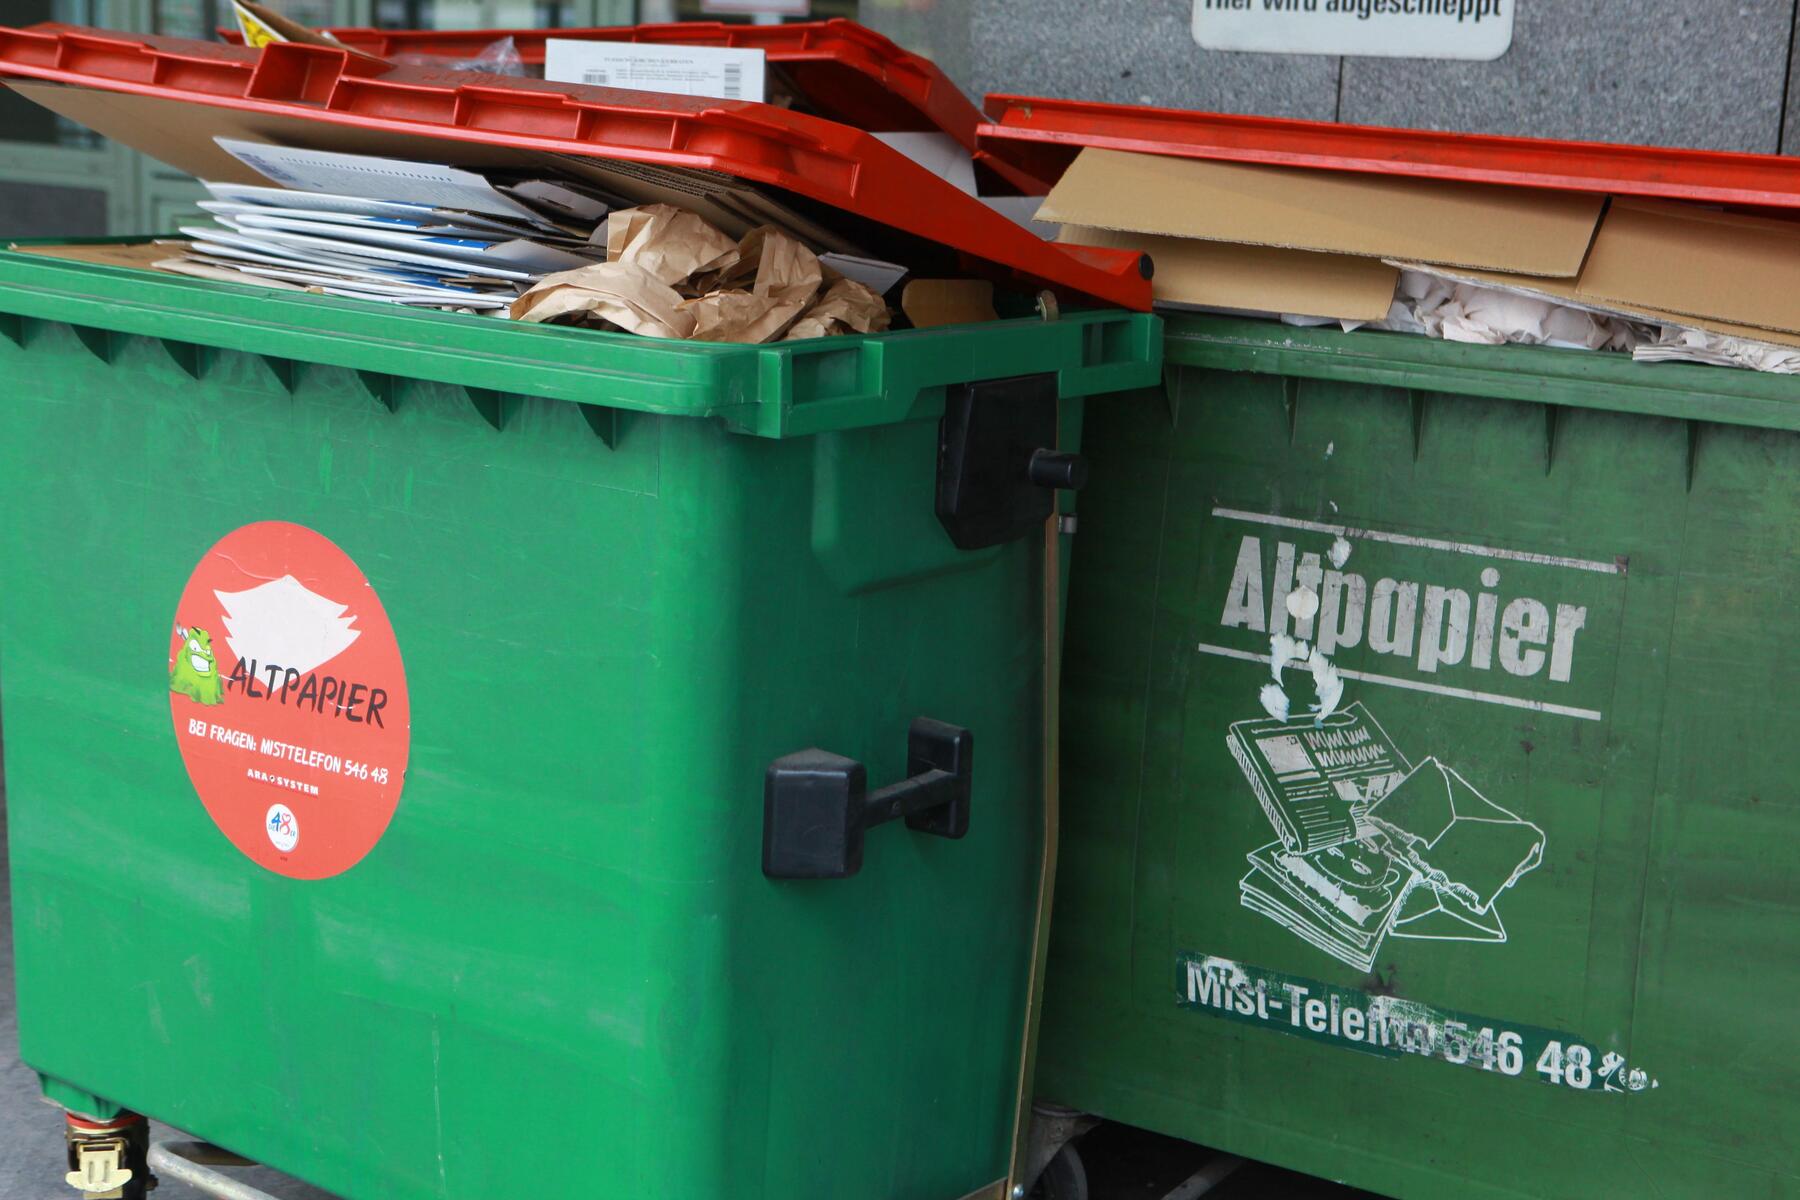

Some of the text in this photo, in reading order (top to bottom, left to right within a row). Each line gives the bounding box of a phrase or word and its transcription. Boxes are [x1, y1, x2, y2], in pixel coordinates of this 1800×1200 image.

[1220, 535, 1587, 683] Altpapier
[226, 656, 388, 729] ALTPAPIER
[188, 718, 388, 785] BEI FRAGEN: MISTTELEFON 546 48
[277, 776, 319, 795] SYSTEM
[1444, 1019, 1524, 1076] 546
[1536, 1040, 1593, 1089] 48
